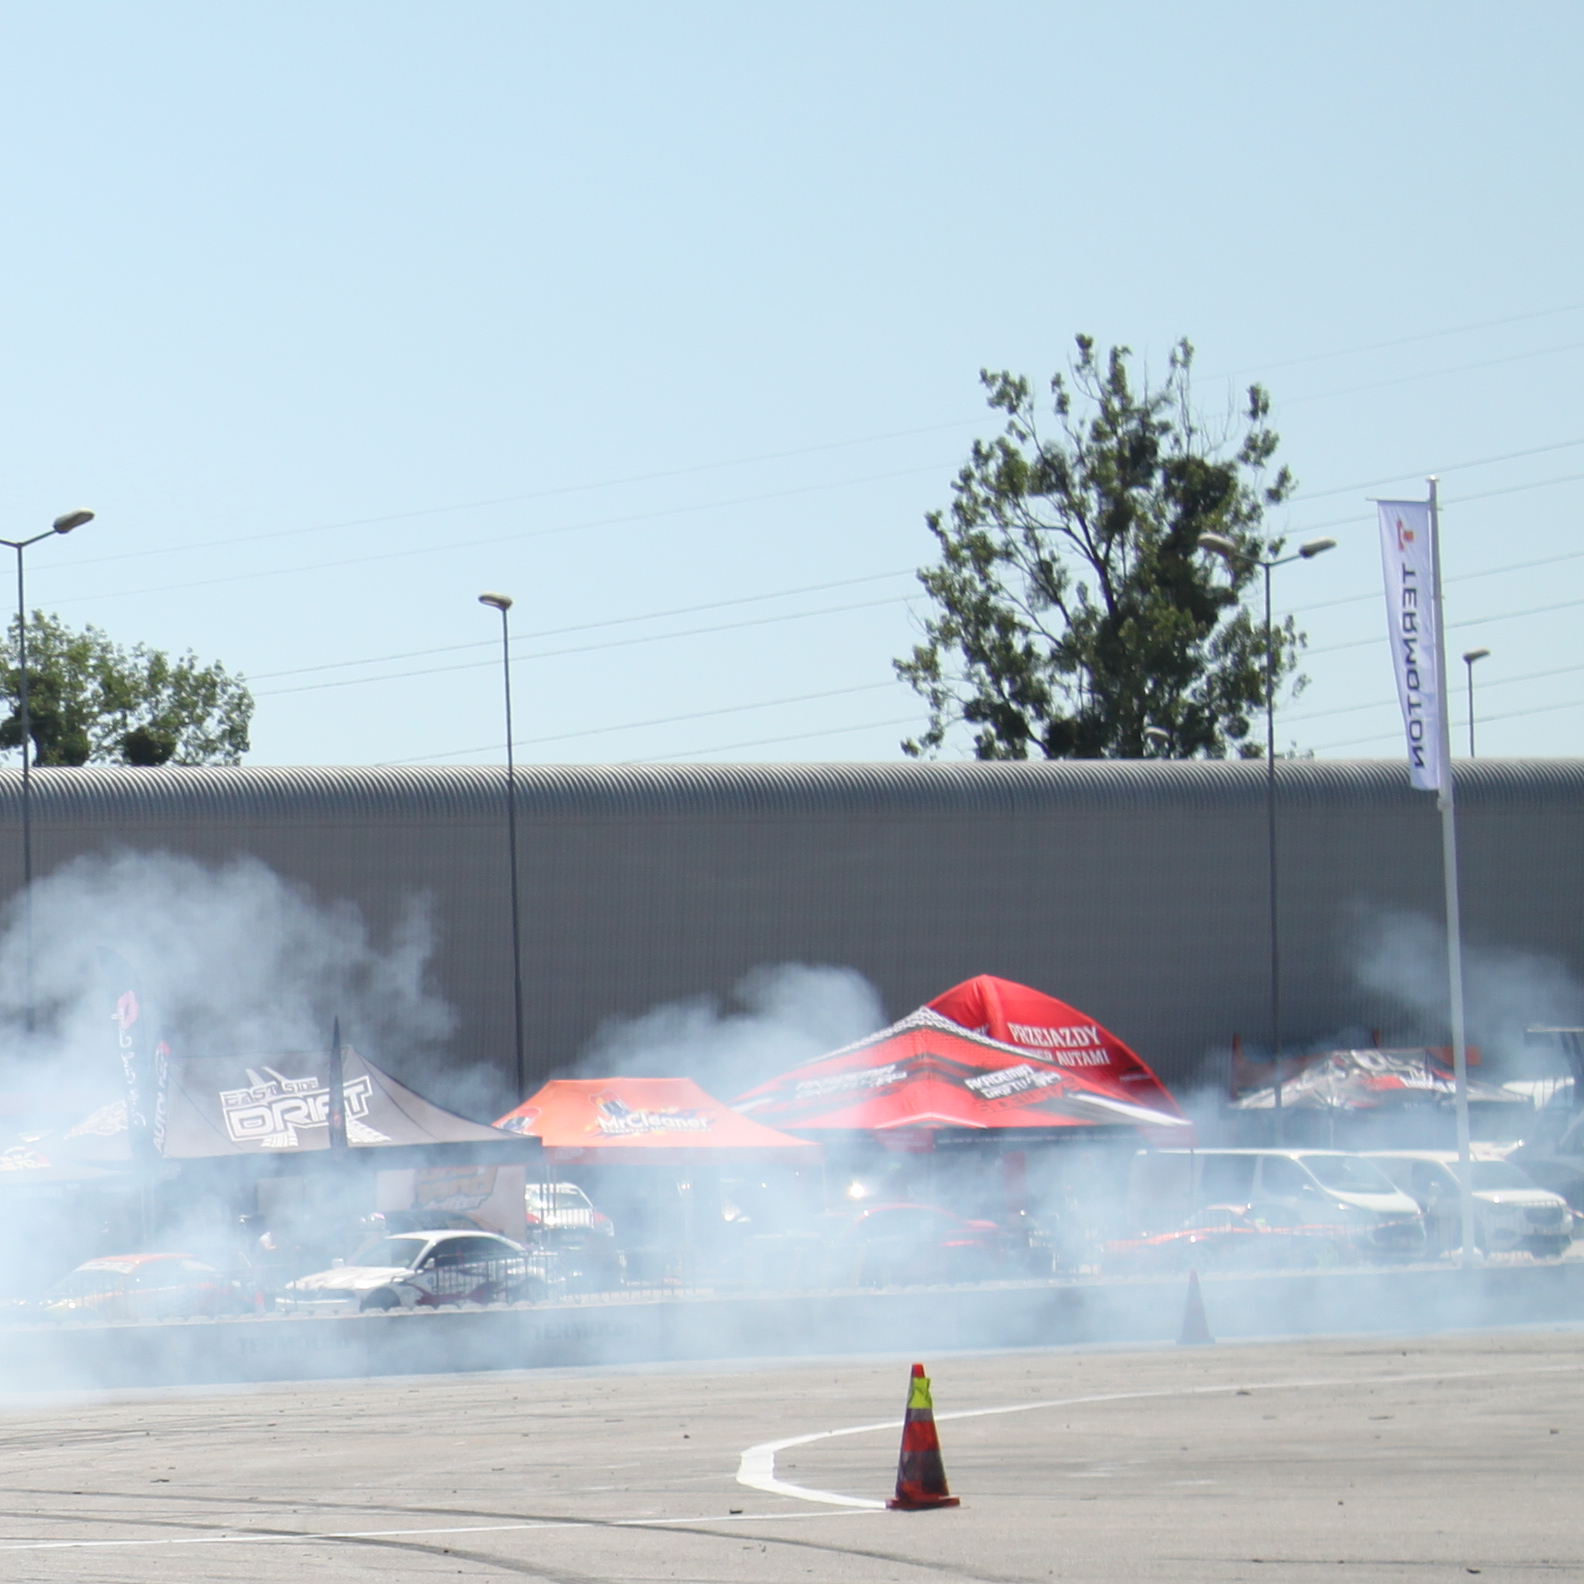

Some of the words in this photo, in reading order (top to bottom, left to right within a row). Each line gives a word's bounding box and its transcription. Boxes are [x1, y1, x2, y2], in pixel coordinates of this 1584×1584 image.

[1056, 1048, 1111, 1067] AUTAMI
[223, 1083, 278, 1106] EAST
[284, 1079, 319, 1094] SIDE
[597, 1111, 709, 1130] MrCleaner
